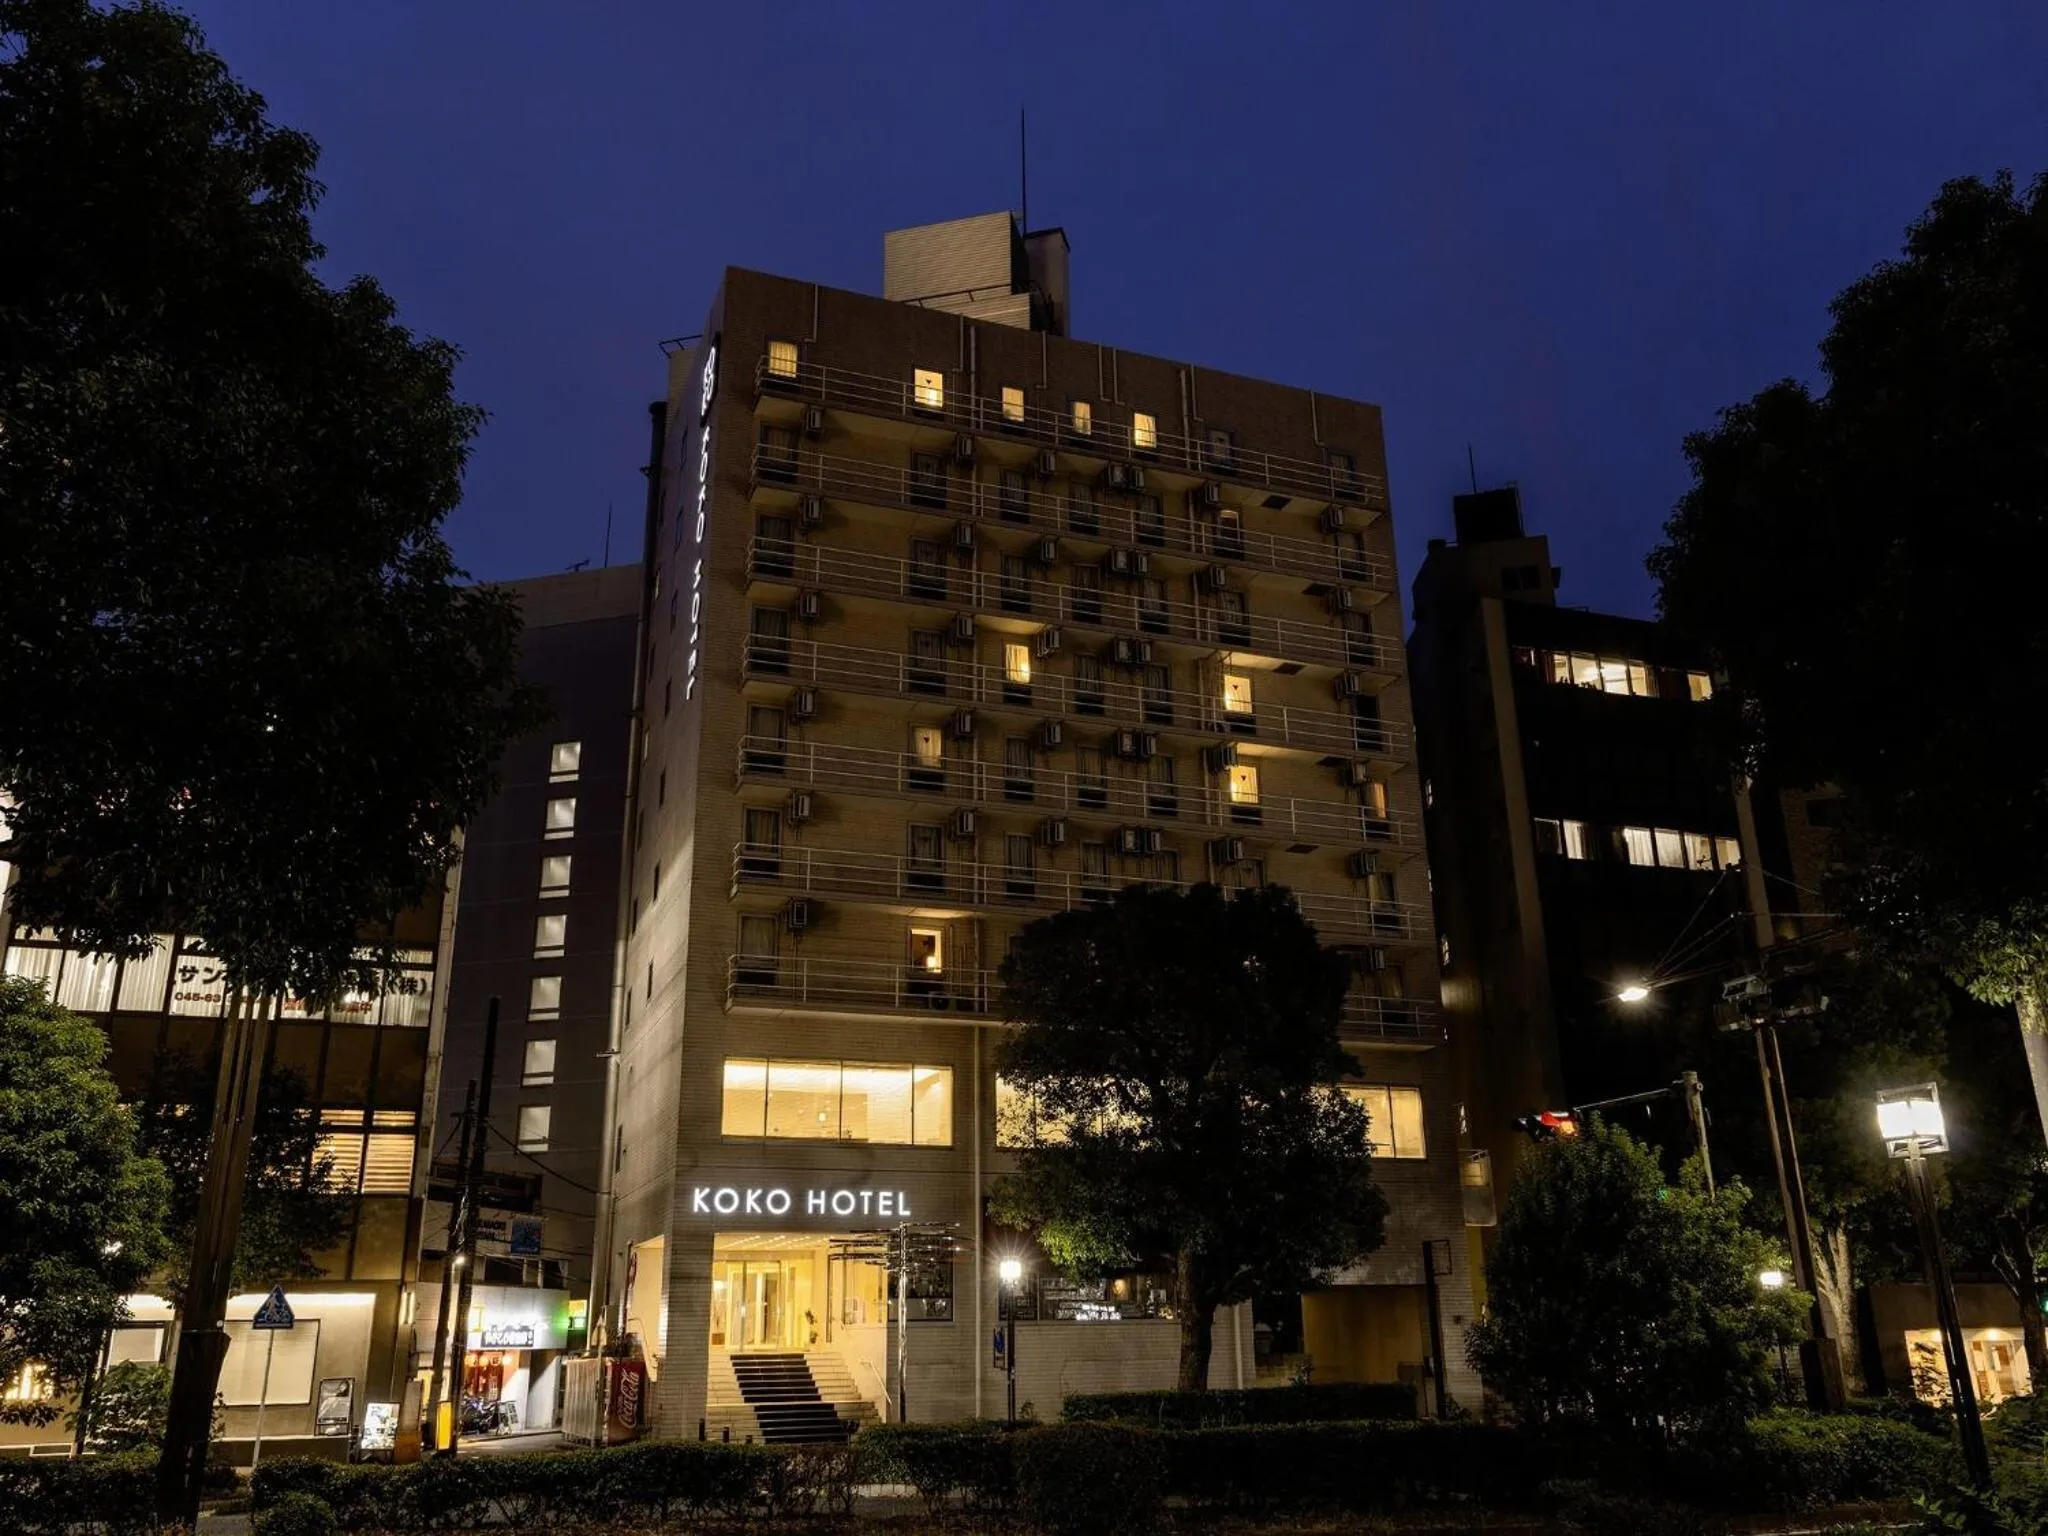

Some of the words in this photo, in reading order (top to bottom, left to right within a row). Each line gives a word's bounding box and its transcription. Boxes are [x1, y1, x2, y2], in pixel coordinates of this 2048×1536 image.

[696, 425, 710, 543] KOKO
[685, 558, 702, 700] HOTEL
[692, 1187, 792, 1214] KOKO
[807, 1189, 911, 1216] HOTEL
